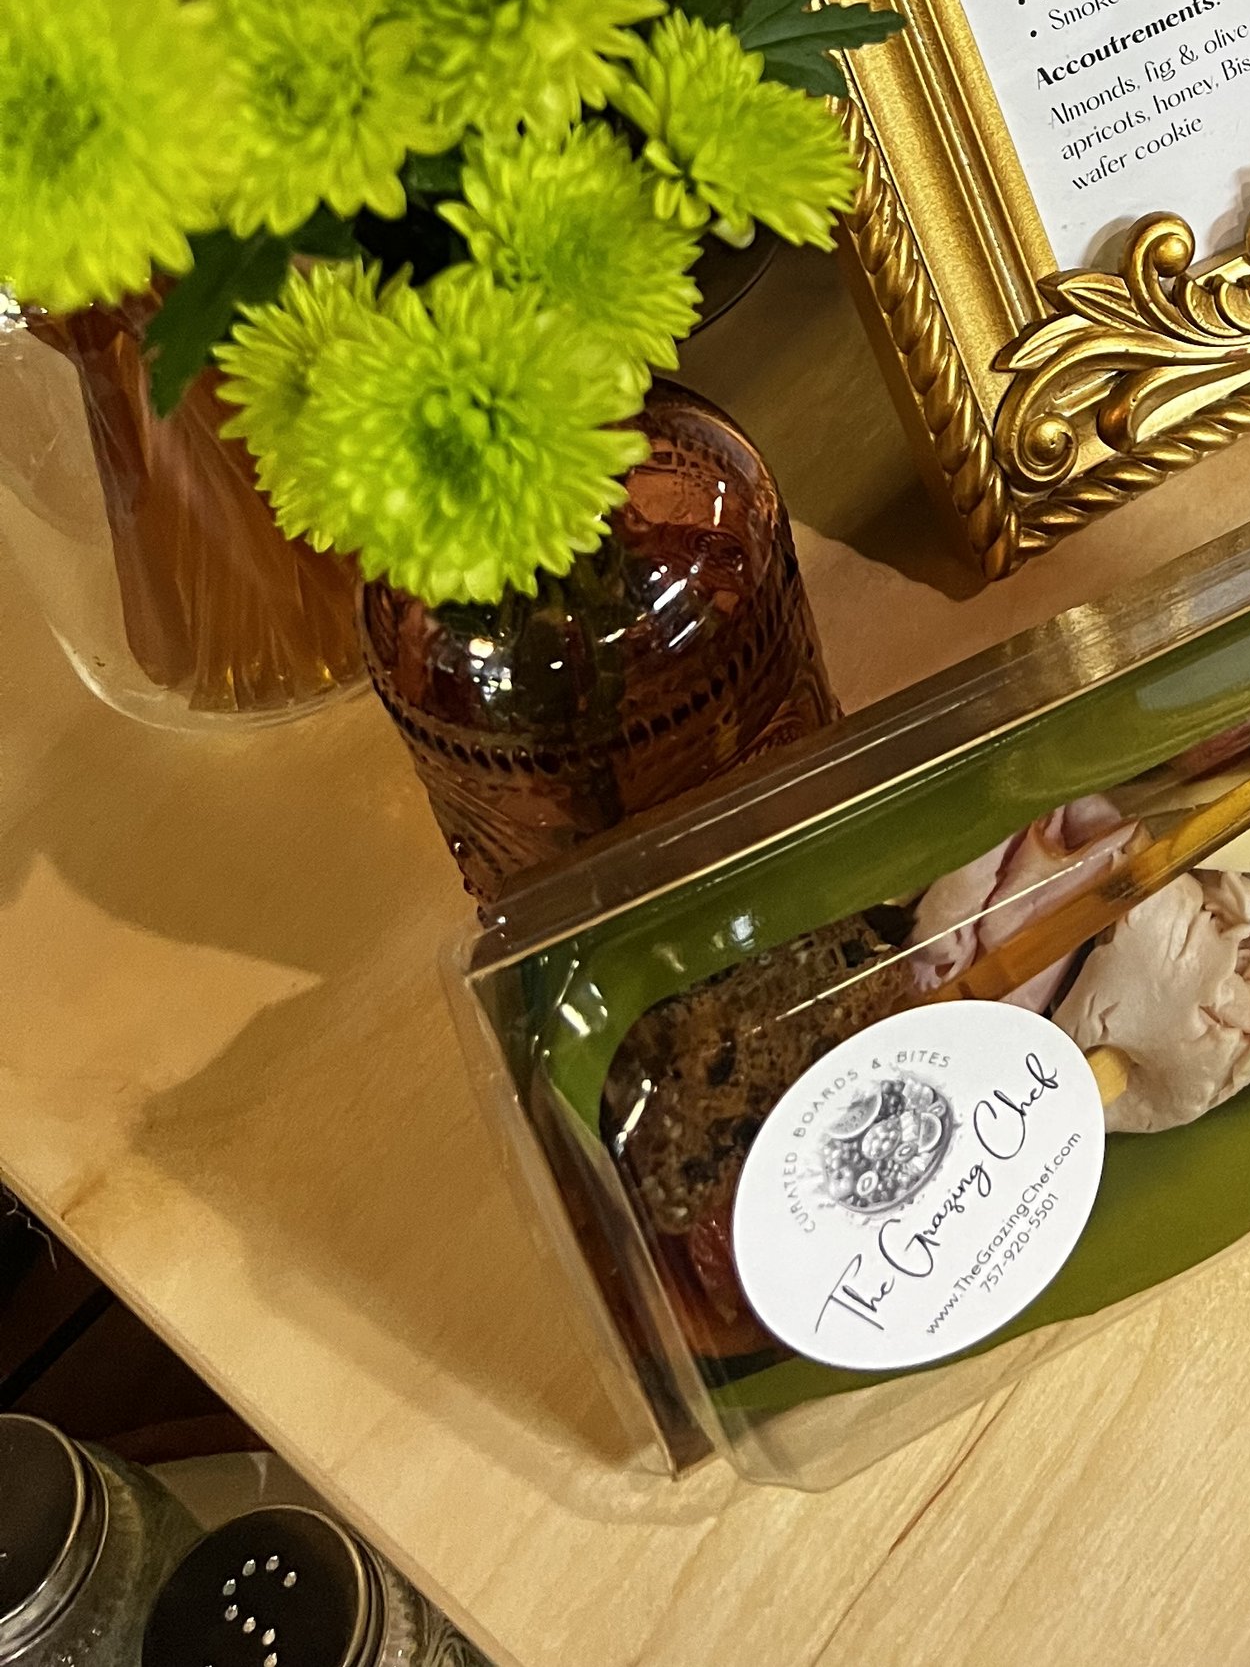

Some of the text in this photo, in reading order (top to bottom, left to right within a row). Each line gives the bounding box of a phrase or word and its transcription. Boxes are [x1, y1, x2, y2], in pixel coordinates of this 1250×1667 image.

[1048, 75, 1141, 129] Almonds,
[1144, 58, 1176, 83] fig
[1178, 44, 1199, 66] &
[1203, 23, 1249, 54] olive
[1061, 109, 1151, 161] apricots,
[1153, 76, 1219, 115] honey,
[1072, 117, 1204, 191] wafer cookie
[896, 1050, 952, 1069] BITES
[792, 1069, 859, 1138] BOARDS
[782, 1150, 816, 1234] CURATED
[815, 1052, 1060, 1334] The Grazing Chef
[926, 1131, 1083, 1335] www.TheGrazingChef.com
[979, 1191, 1061, 1295] 757-920-5501
